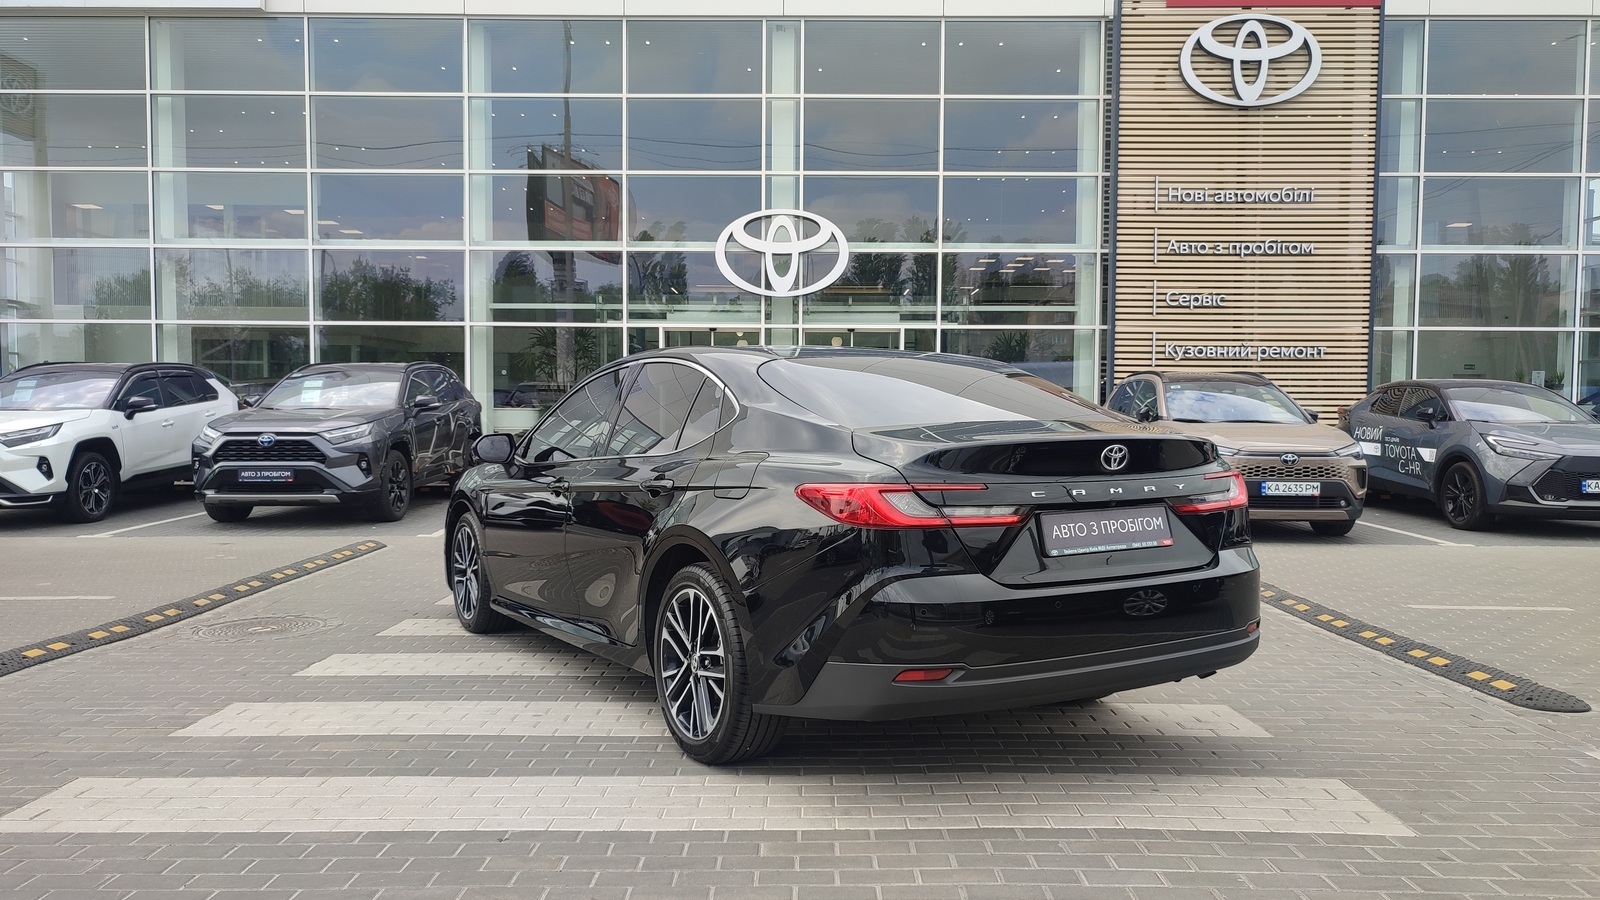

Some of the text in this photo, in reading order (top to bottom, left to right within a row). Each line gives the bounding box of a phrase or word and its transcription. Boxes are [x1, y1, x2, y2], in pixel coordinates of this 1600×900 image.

[1167, 187, 1315, 203] Нові автомобілі
[1166, 239, 1315, 258] Авто з пробігом
[1166, 290, 1227, 310] Сервіс
[1164, 341, 1327, 361] Кузовний ремонт
[1353, 425, 1383, 441] НОВИЙ
[1384, 444, 1417, 460] TOYOTA
[1398, 460, 1422, 475] C-HR
[1031, 483, 1185, 498] CAMRY
[1282, 483, 1304, 493] 2635
[1052, 516, 1164, 539] АВТО З ПРОБІГОМ
